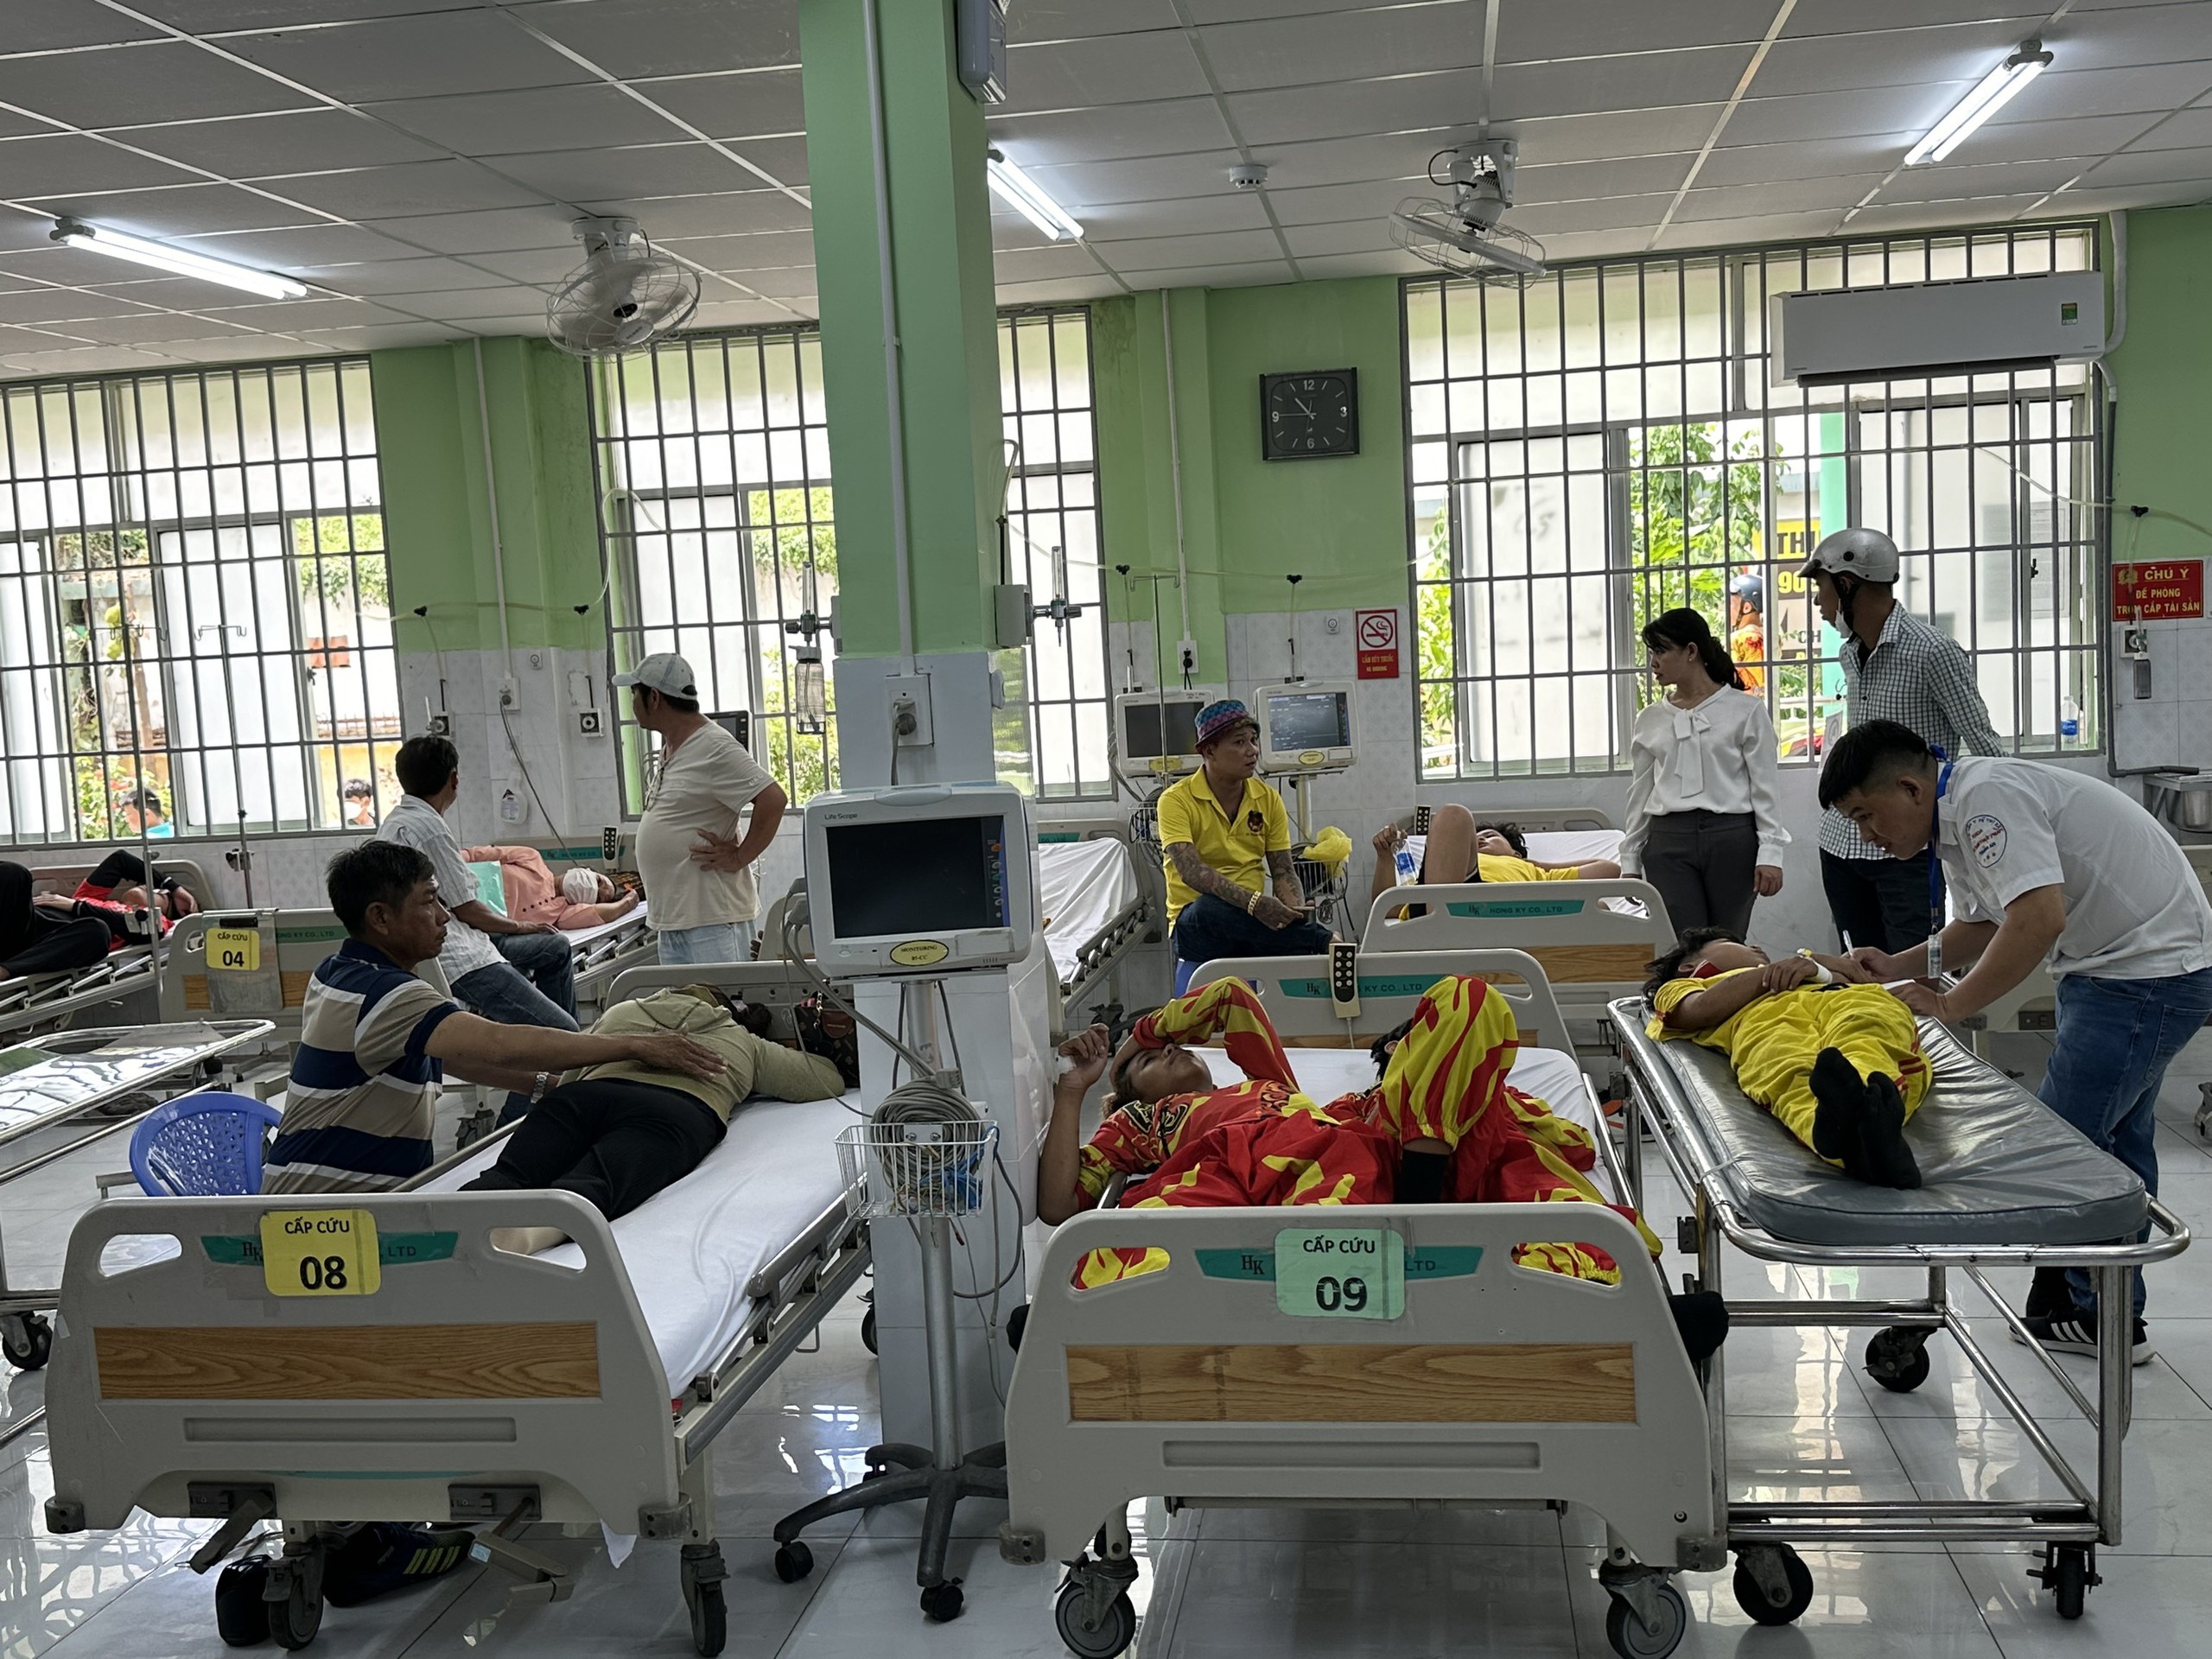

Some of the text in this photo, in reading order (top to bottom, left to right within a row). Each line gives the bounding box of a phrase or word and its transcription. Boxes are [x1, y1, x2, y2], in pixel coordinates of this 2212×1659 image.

[1303, 379, 1315, 391] 12
[1272, 411, 1280, 423] 9
[1339, 406, 1348, 417] 3
[1306, 438, 1315, 449] 6
[2145, 566, 2190, 580] CHÚ Ý
[222, 950, 245, 968] 04
[1306, 982, 1320, 995] HK
[284, 1217, 350, 1234] CẤP CỨU
[389, 1245, 416, 1257] LTD
[1302, 1235, 1376, 1254] CẤP CỨU
[1241, 1255, 1436, 1275] HK LTD
[300, 1255, 347, 1290] 08
[1315, 1275, 1368, 1312] 09
